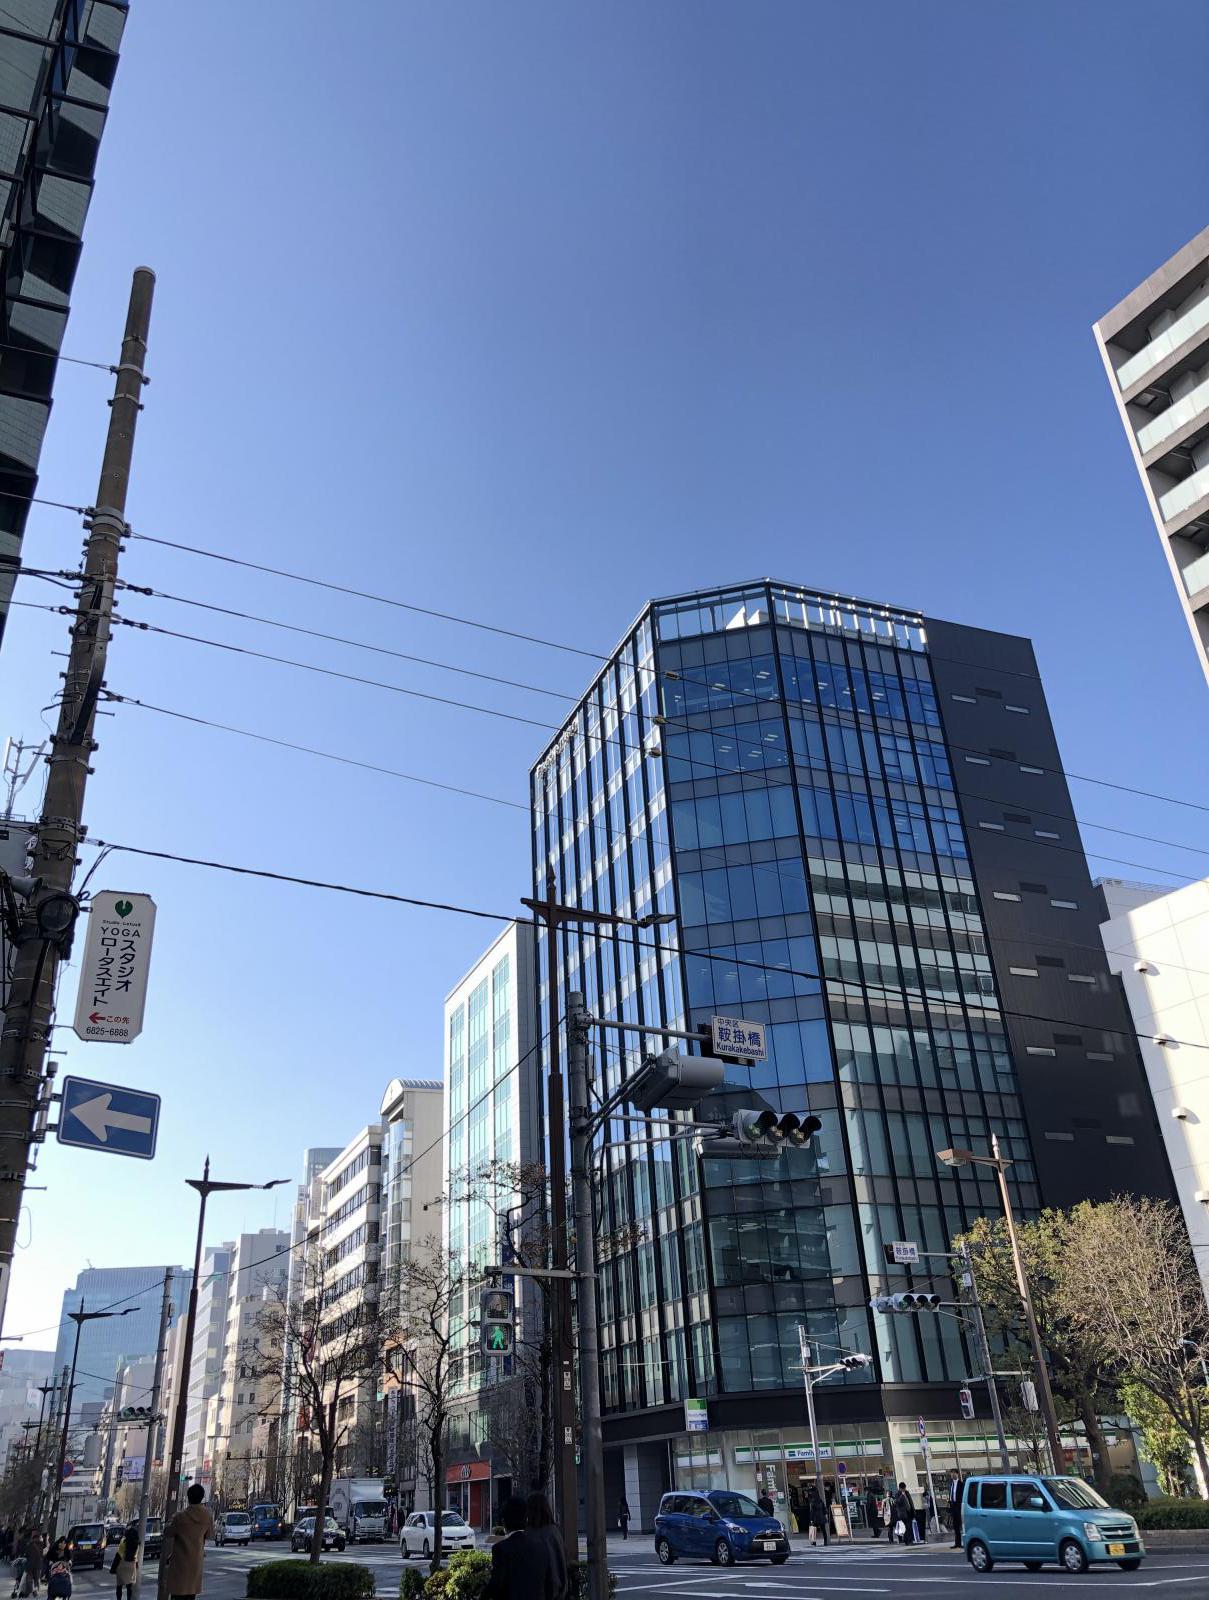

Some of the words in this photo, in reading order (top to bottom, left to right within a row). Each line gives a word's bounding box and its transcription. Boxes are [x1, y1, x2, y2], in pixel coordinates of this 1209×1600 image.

[100, 926, 141, 938] YOGA
[93, 937, 117, 1007] ロータスエイト
[115, 939, 137, 993] スタジオ
[106, 1015, 130, 1025] この先
[86, 1026, 129, 1037] 6825-6888
[718, 1026, 761, 1047] 鞍掛橋
[716, 1041, 764, 1056] Kurakakebashi
[797, 1449, 829, 1457] Familyart
